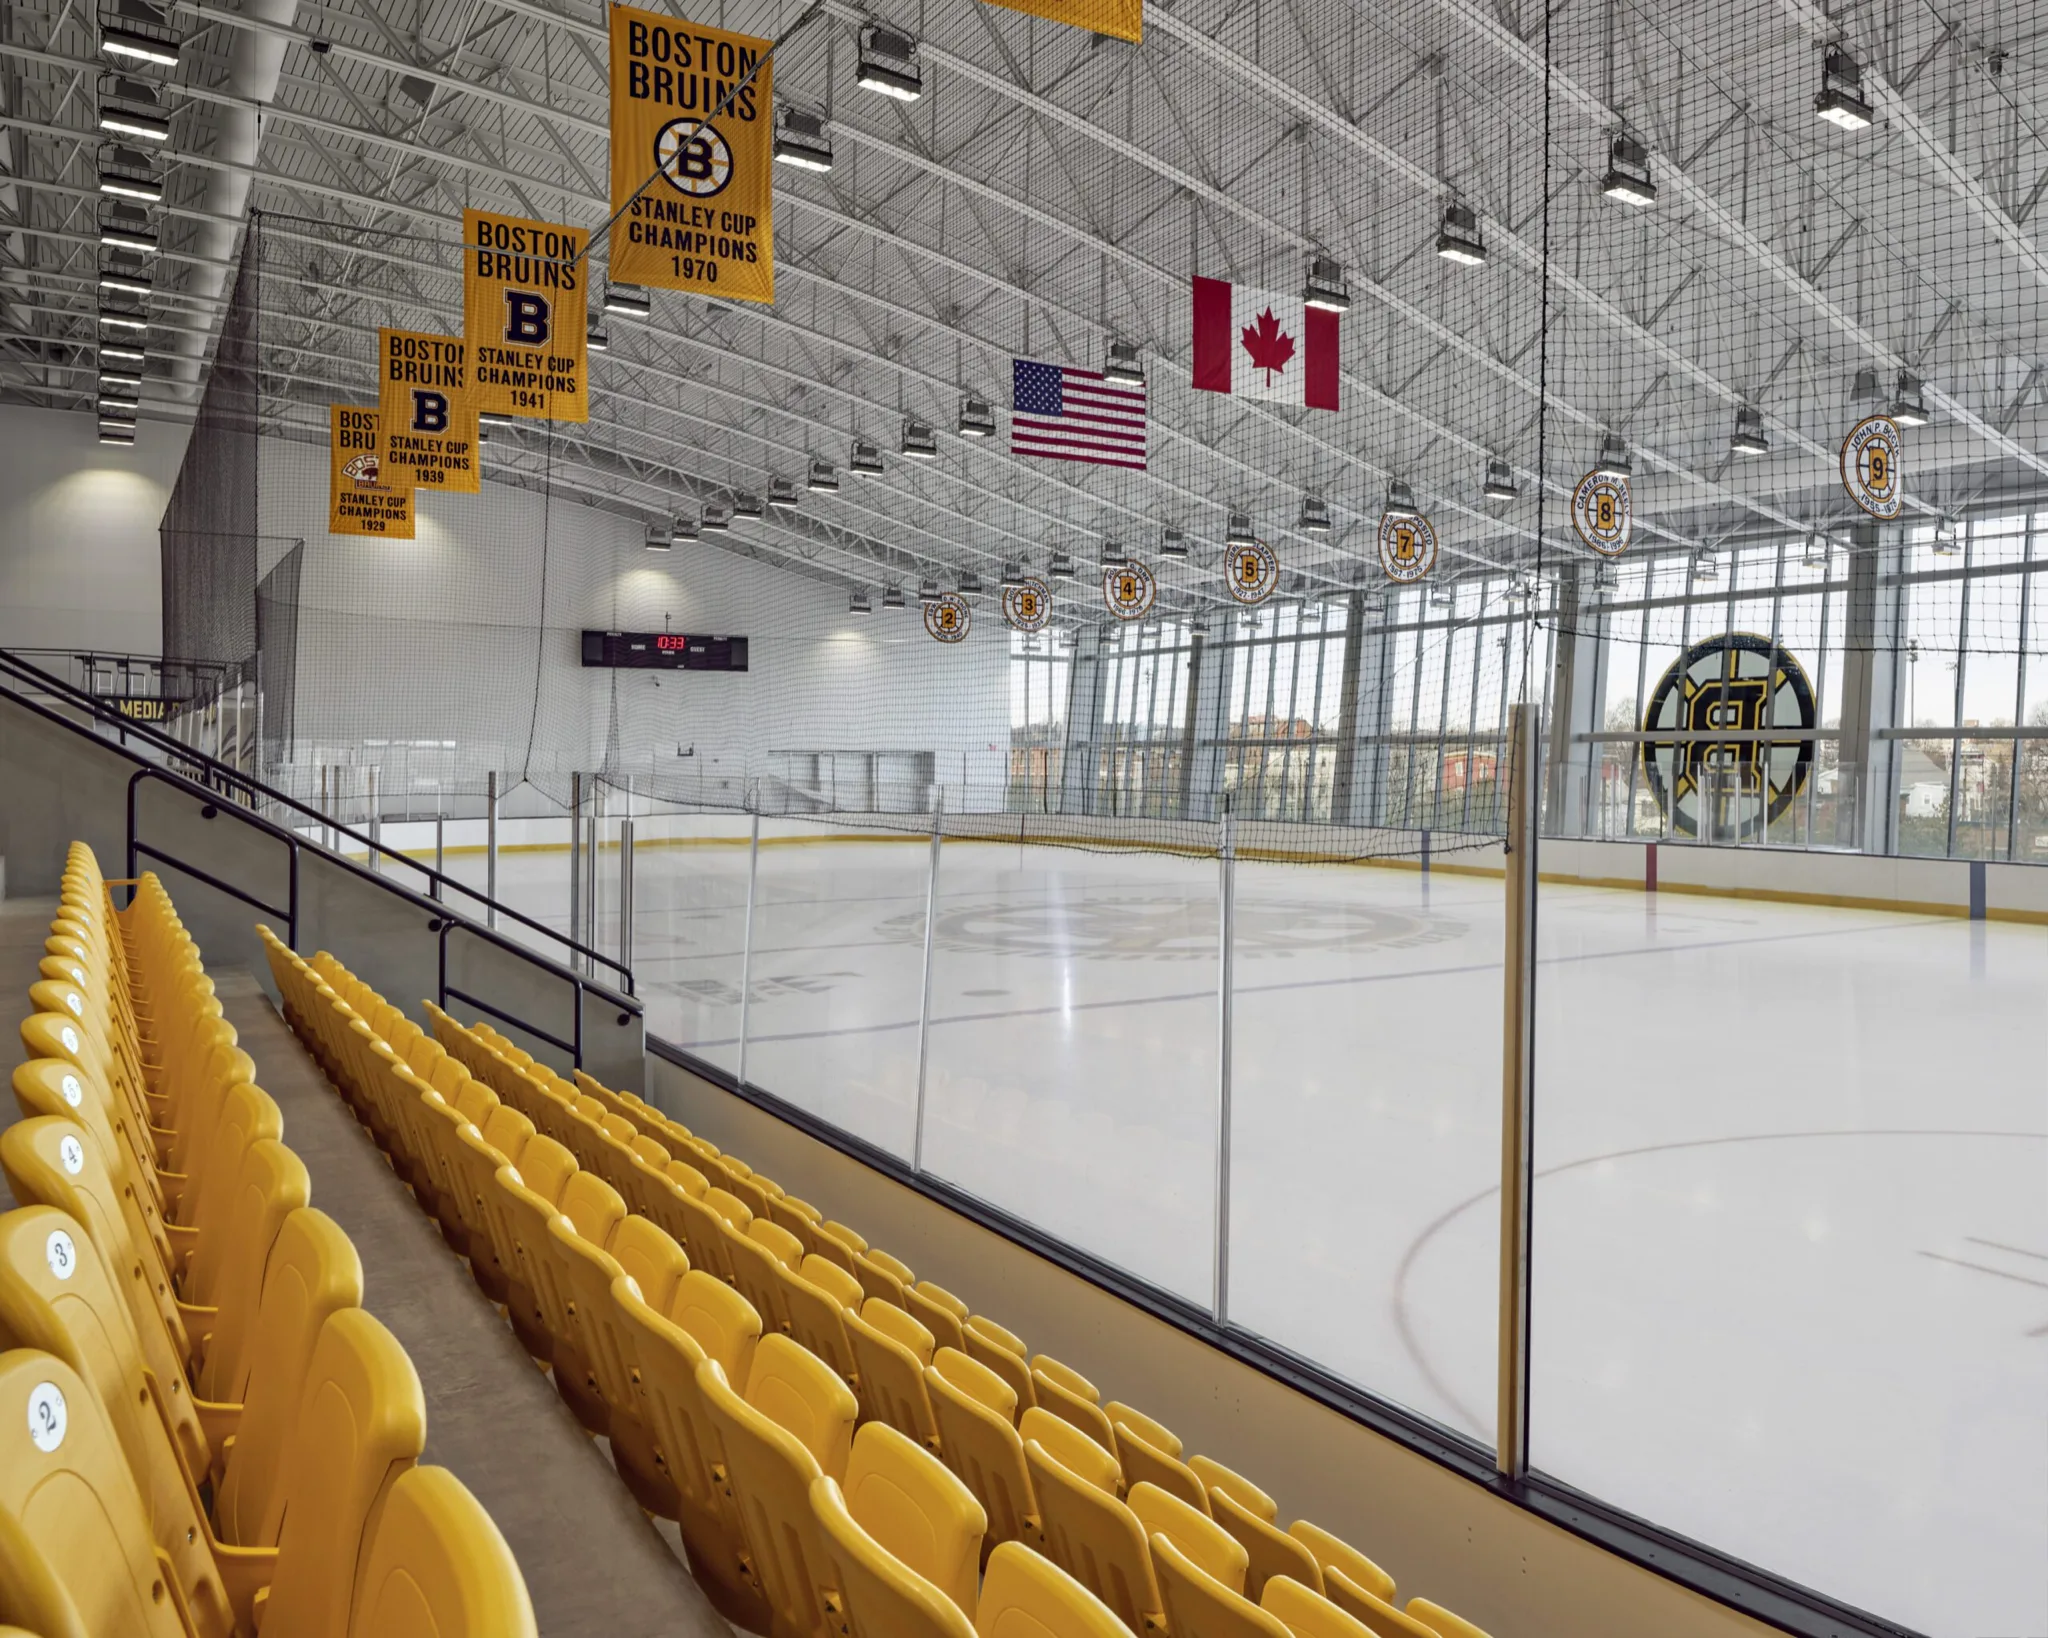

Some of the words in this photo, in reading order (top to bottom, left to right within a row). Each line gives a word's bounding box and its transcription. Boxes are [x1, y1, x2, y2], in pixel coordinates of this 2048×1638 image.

[629, 20, 757, 83] BOSTON
[629, 61, 757, 121] BRUINS
[630, 196, 715, 229] STANLEY
[721, 211, 756, 236] CUP
[477, 220, 576, 259] BOSTON
[629, 221, 757, 264] CHAMPIONS
[477, 251, 576, 290] BRUINS
[672, 255, 717, 283] 1970
[503, 287, 552, 348] B
[478, 347, 543, 370] STANLEY
[548, 356, 575, 374] CUP
[477, 367, 576, 393] CHAMPIONS
[510, 390, 544, 409] 1941
[340, 411, 380, 431] BOST
[410, 387, 450, 435] B
[340, 430, 375, 450] BRU
[390, 436, 443, 453] STANLEY
[446, 441, 468, 455] CUP
[1851, 424, 1872, 452] JOHN
[389, 451, 470, 470] CHAMPIONS
[1872, 457, 1884, 480] 9
[415, 469, 444, 483] 1939
[340, 492, 384, 507] STANLEY
[387, 497, 406, 508] CUP
[1577, 474, 1609, 509] CAMERON
[339, 505, 407, 520] CHAMPIONS
[1601, 502, 1611, 522] 8
[361, 520, 386, 531] 1929
[1409, 516, 1433, 546] POSITO
[1401, 536, 1410, 552] 7
[1254, 543, 1276, 572] LAPPER
[1245, 562, 1254, 577] 5
[1123, 582, 1132, 595] 4
[1025, 598, 1033, 611] 3
[945, 612, 953, 624] 2
[658, 636, 685, 649] 10:33
[120, 699, 165, 720] MEDIA
[68, 1145, 78, 1165] 4
[54, 1243, 68, 1267] 3
[38, 1400, 57, 1435] 2
